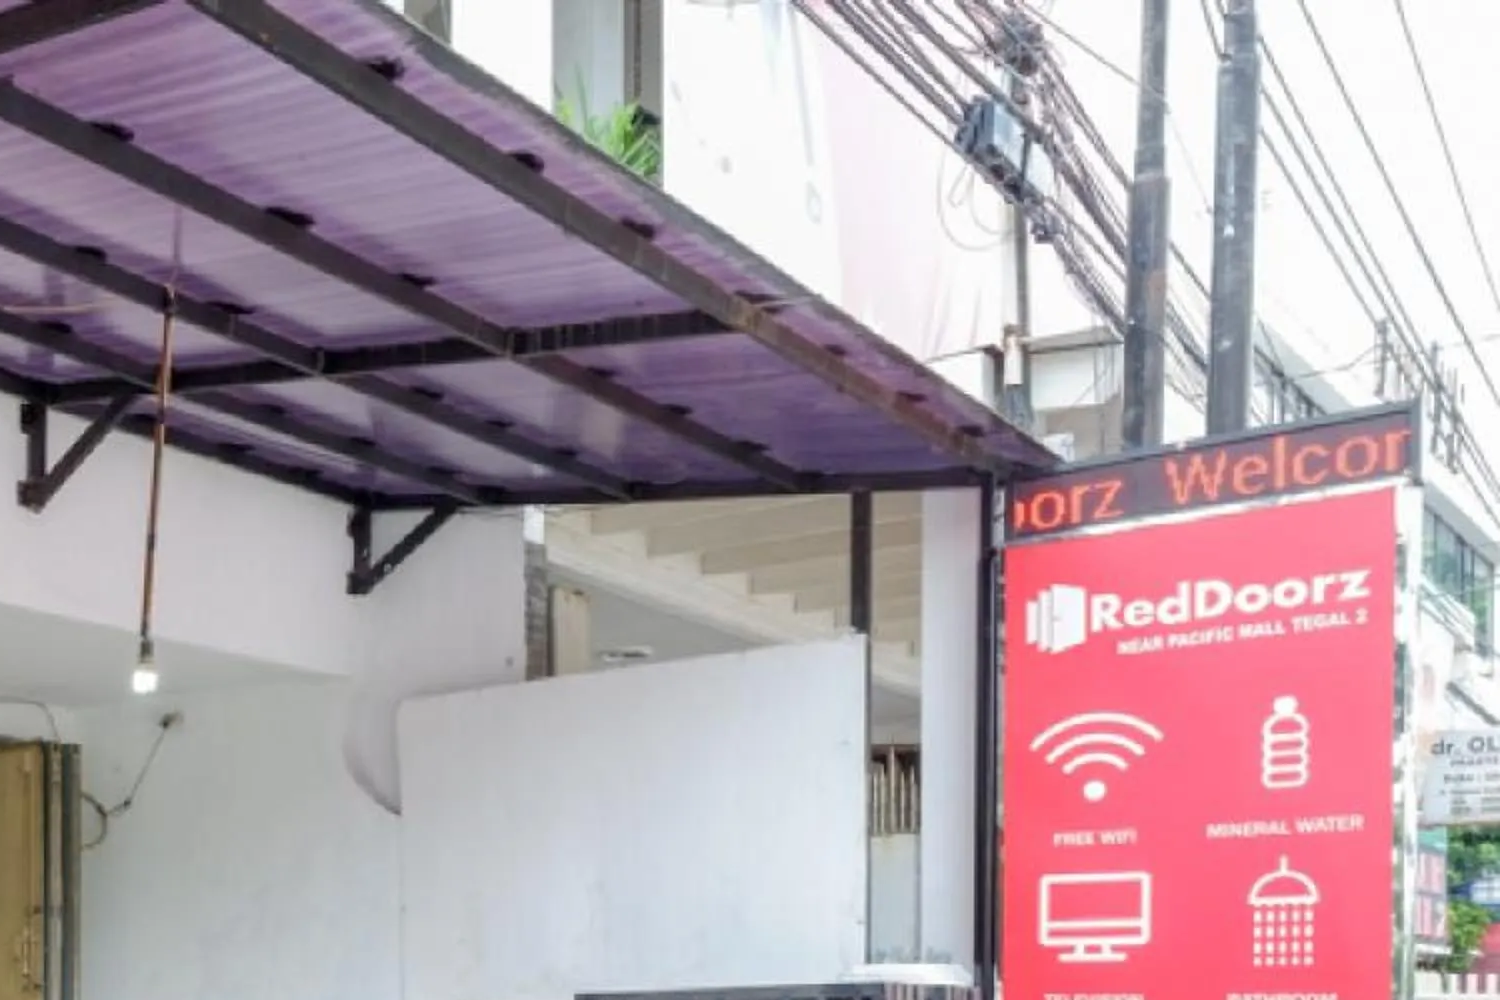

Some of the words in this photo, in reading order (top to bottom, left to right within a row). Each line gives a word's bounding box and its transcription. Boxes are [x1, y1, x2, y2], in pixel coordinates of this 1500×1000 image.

[1091, 569, 1371, 632] RedDoorz
[1116, 635, 1164, 655] NEAR
[1167, 624, 1233, 649] PACIFIC
[1239, 619, 1286, 639] MALL
[1291, 611, 1351, 633] TEGAL
[1053, 829, 1094, 847] FREE
[1206, 820, 1290, 839] MINERAL
[1295, 814, 1365, 833] WATER
